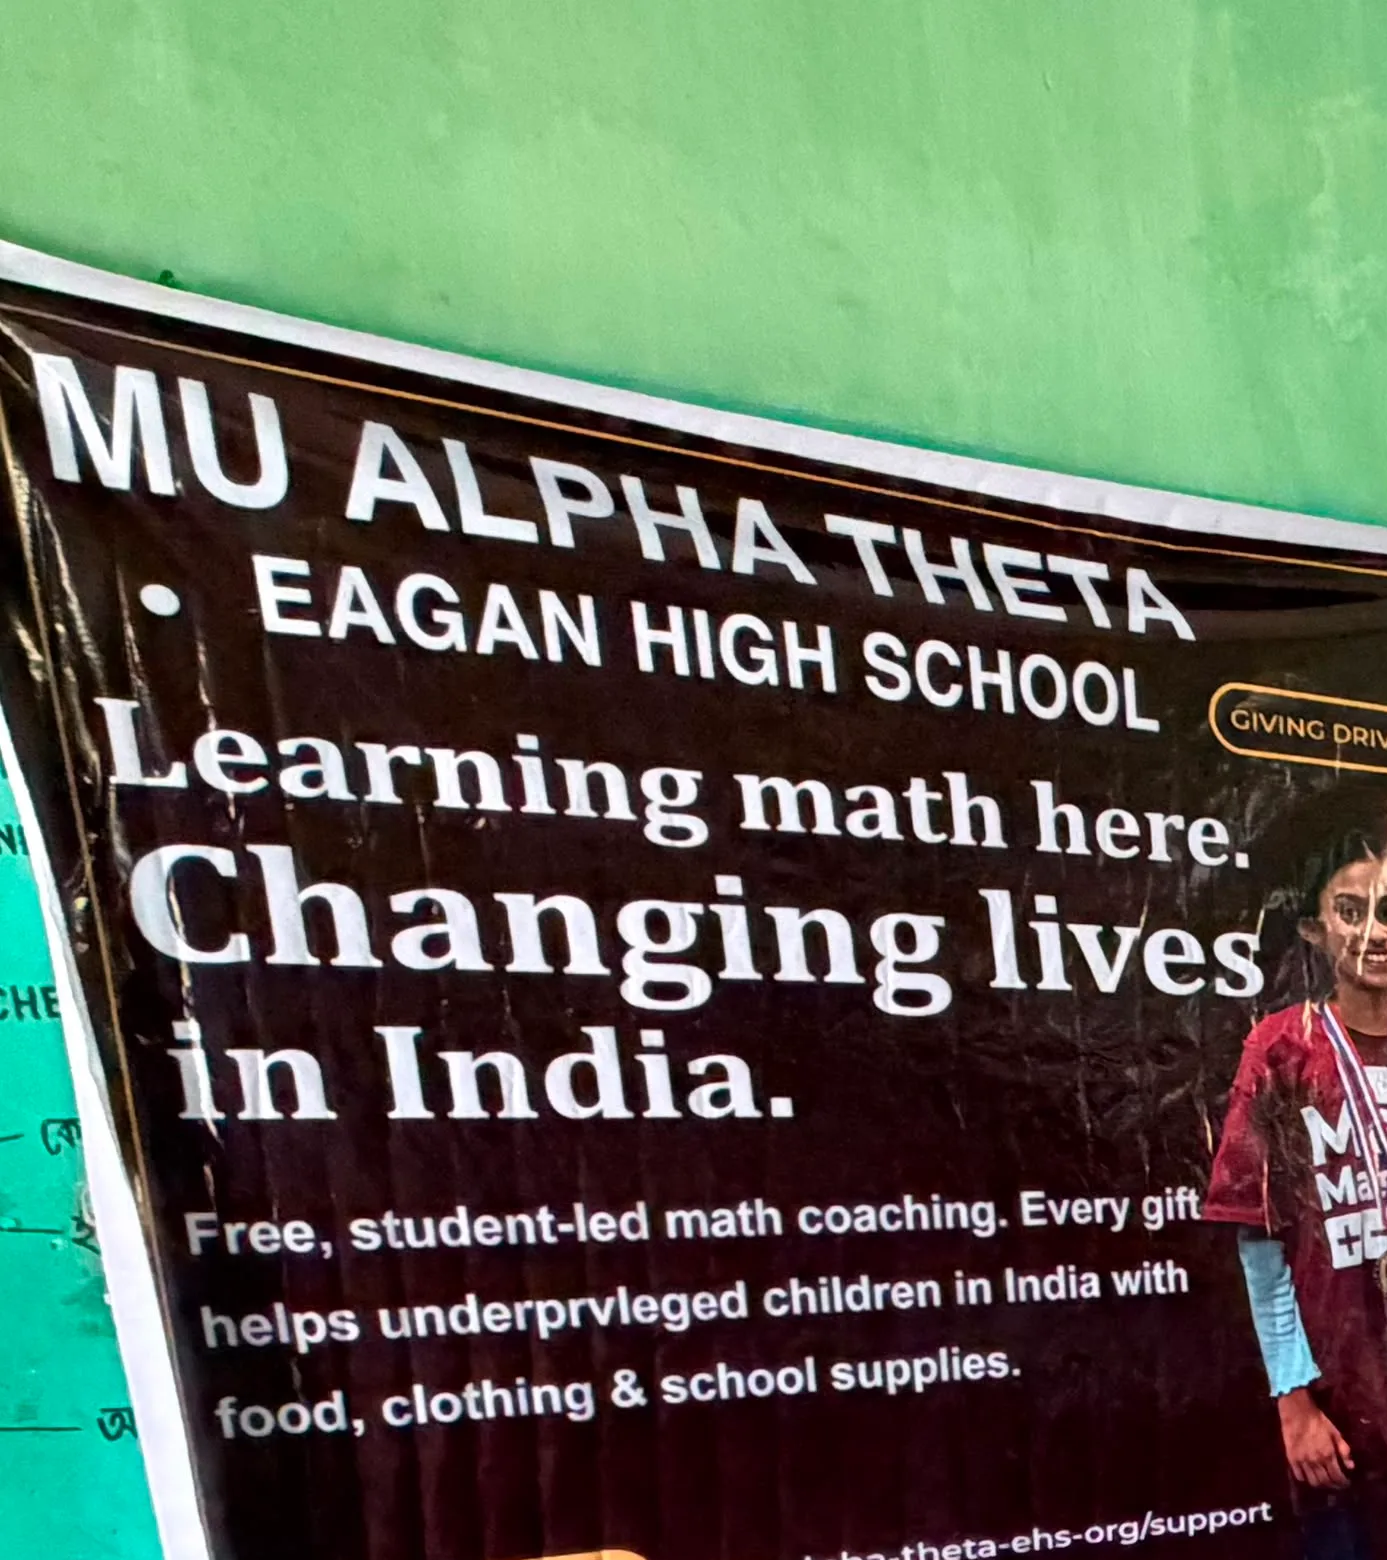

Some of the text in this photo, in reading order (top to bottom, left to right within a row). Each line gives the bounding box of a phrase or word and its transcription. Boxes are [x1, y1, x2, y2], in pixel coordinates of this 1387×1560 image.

[32, 351, 1197, 641] MU ALPHA THETA
[251, 553, 1161, 733] EAGAN HIGH SCHOOL
[1230, 707, 1326, 743] GIVING
[93, 697, 1251, 868] Learning math here.
[129, 842, 1266, 1018] Changing lives
[166, 1019, 795, 1121] in India.
[184, 1186, 1200, 1259] Free, student-led math coaching. Every gift
[201, 1260, 1189, 1354] helps underprvleged children in India with
[214, 1347, 1022, 1440] food, clothing & school supplies.
